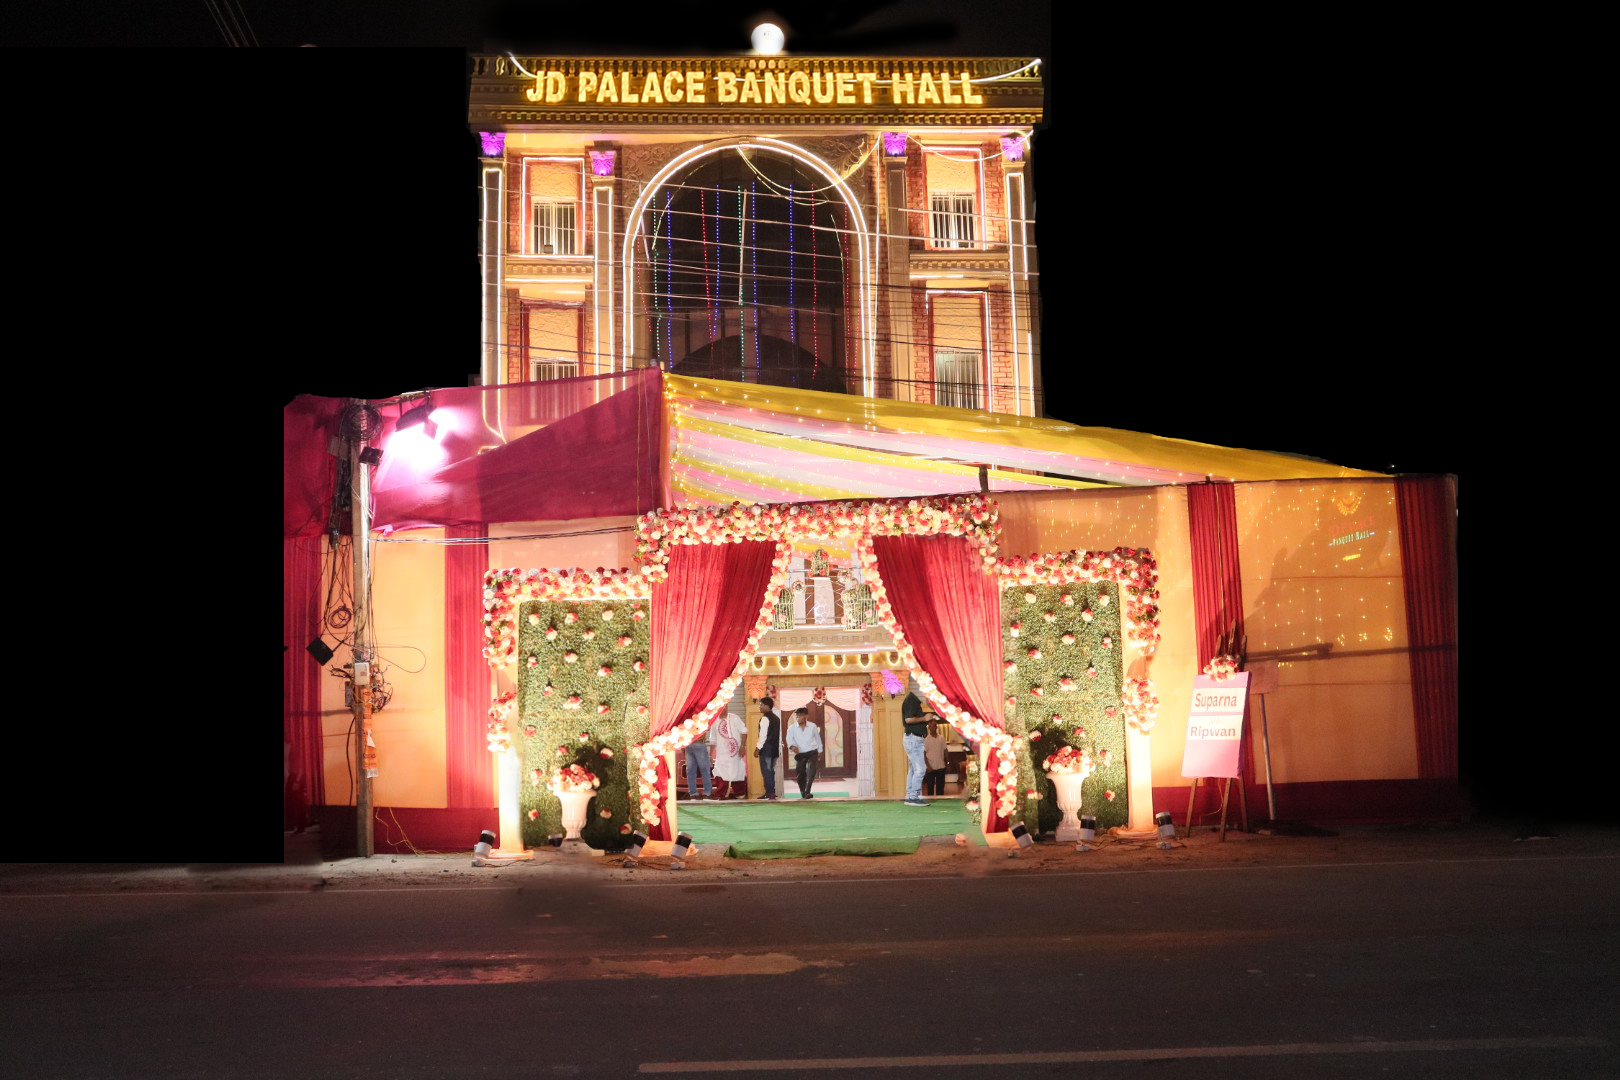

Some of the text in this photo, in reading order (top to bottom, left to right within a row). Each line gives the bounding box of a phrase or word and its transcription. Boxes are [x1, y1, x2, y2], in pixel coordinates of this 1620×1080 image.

[526, 70, 983, 105] JD PALACE BANQUET HALL
[1195, 693, 1237, 711] Suparna
[1190, 726, 1236, 740] Ripwan
